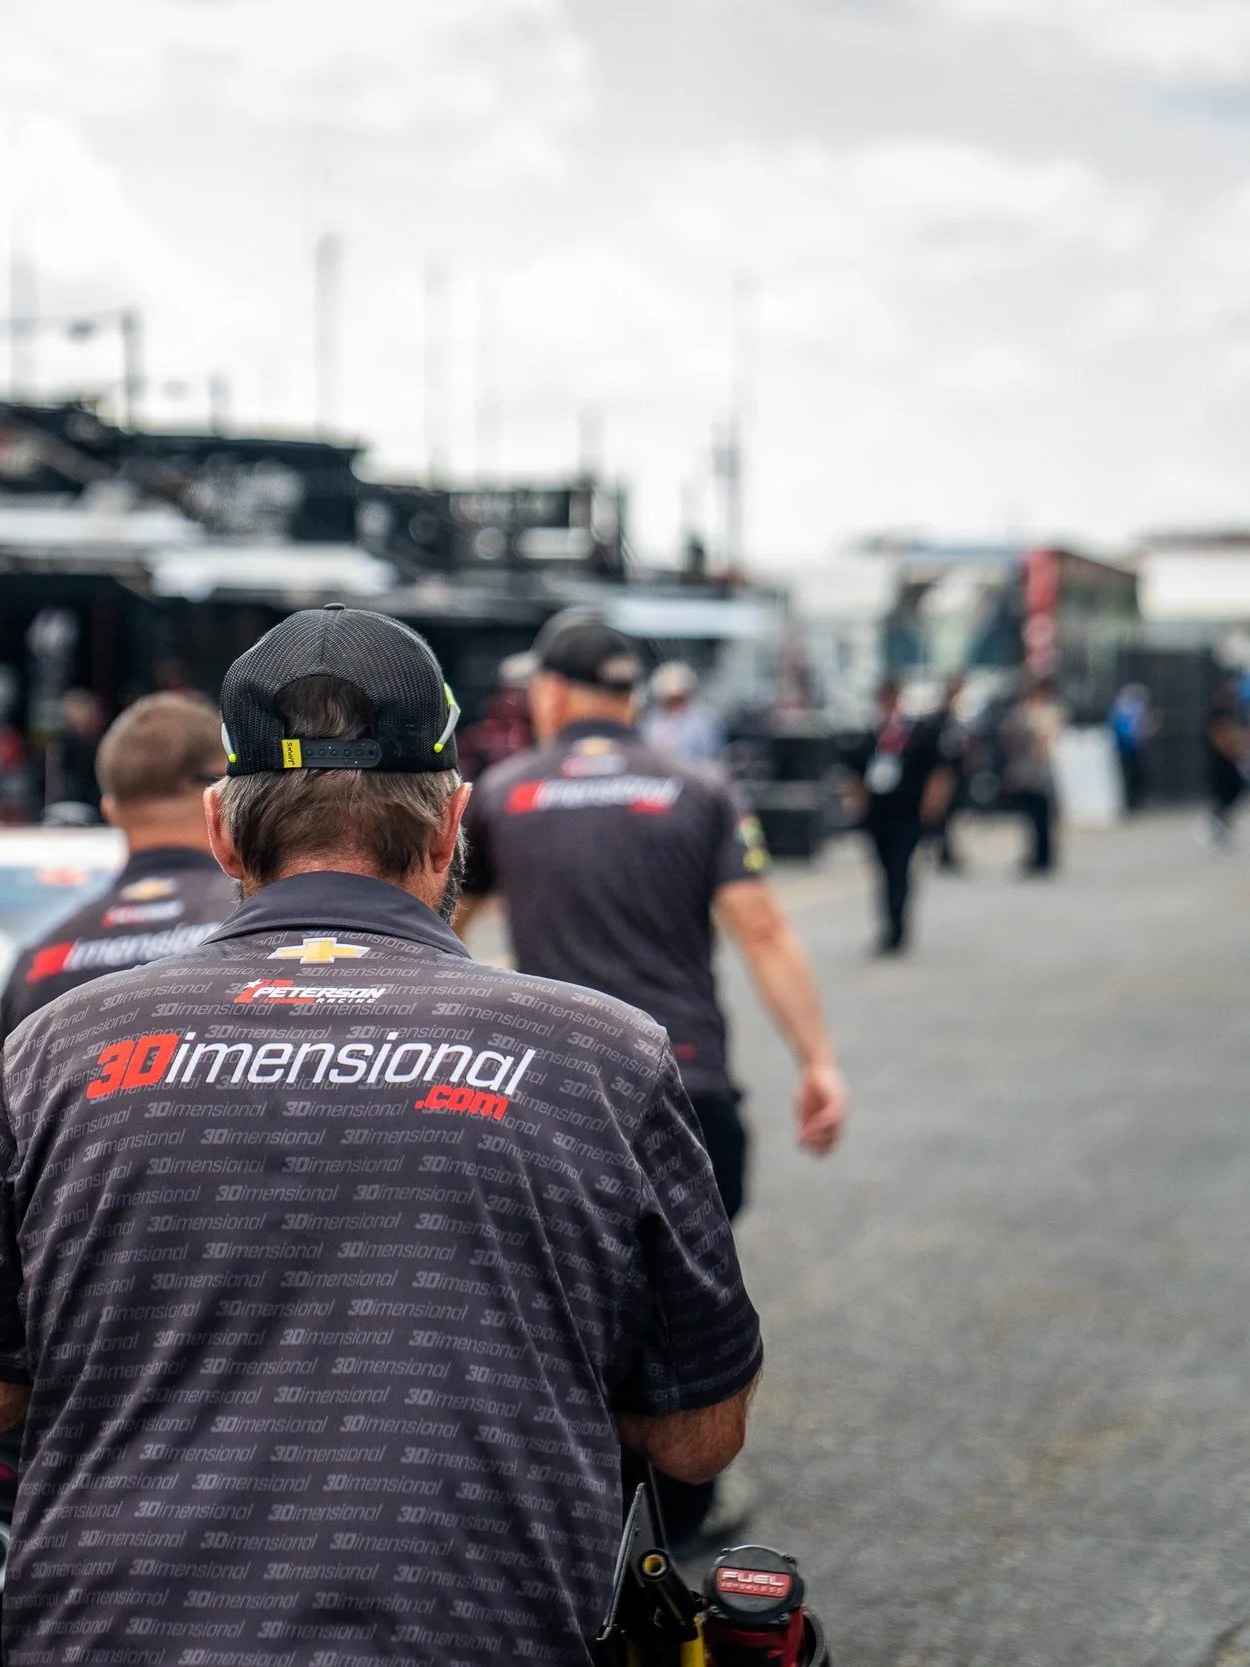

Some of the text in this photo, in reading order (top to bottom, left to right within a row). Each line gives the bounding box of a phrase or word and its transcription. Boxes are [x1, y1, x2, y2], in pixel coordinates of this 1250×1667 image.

[252, 987, 386, 999] PETERSON
[152, 1002, 275, 1016] 3Dimensional
[288, 1002, 418, 1016] 3Dimensional
[507, 992, 623, 1037] 3Dimensional
[432, 1003, 556, 1036] 3Dimensional
[205, 1025, 333, 1040] 3Dimensional
[86, 1031, 536, 1101] 3Dimensional
[145, 1101, 268, 1118] 3Dimensional
[282, 1100, 409, 1119] 3Dimensional
[414, 1084, 508, 1120] .com
[200, 1128, 326, 1145] 3Dimensional
[341, 1128, 466, 1145] 3Dimensional
[147, 1157, 266, 1174] 3Dimensional
[281, 1156, 405, 1173] 3Dimensional
[216, 1186, 339, 1201] 3Dimensional
[354, 1184, 475, 1204] 3Dimensional
[147, 1214, 267, 1232] 3Dimensional
[281, 1212, 402, 1231] 3Dimensional
[202, 1242, 325, 1259] 3Dimensional
[337, 1242, 457, 1260] 3Dimensional
[150, 1271, 267, 1290] 3Dimensional
[280, 1270, 398, 1288] 3Dimensional
[215, 1300, 335, 1317] 3Dimensional
[348, 1299, 468, 1321] 3Dimensional
[153, 1328, 266, 1347] 3Dimensional
[279, 1327, 395, 1347] 3Dimensional
[409, 1330, 529, 1360] 3Dimensional
[200, 1358, 318, 1374] 3Dimensional
[331, 1357, 451, 1378] 3Dimensional
[273, 1386, 391, 1404] 3Dimensional
[404, 1388, 522, 1418] 3Dimensional
[211, 1416, 328, 1433] 3Dimensional
[339, 1415, 461, 1438] 3Dimensional
[139, 1445, 257, 1461] 3Dimensional
[270, 1445, 387, 1463] 3Dimensional
[401, 1446, 518, 1477] 3Dimensional
[192, 1474, 311, 1492] 3Dimensional
[324, 1474, 443, 1496] 3Dimensional
[135, 1501, 254, 1520] 3Dimensional
[267, 1504, 382, 1521] 3Dimensional
[78, 1530, 186, 1547] 3Dimensional
[200, 1533, 318, 1550] 3Dimensional
[330, 1533, 453, 1556] 3Dimensional
[129, 1558, 251, 1578] 3Dimensional
[263, 1563, 380, 1581] 3Dimensional
[722, 1571, 785, 1586] FUEL
[183, 1590, 301, 1609] 3Dimensional
[125, 1618, 245, 1638] 3Dimensional
[257, 1621, 377, 1640] 3Dimensional
